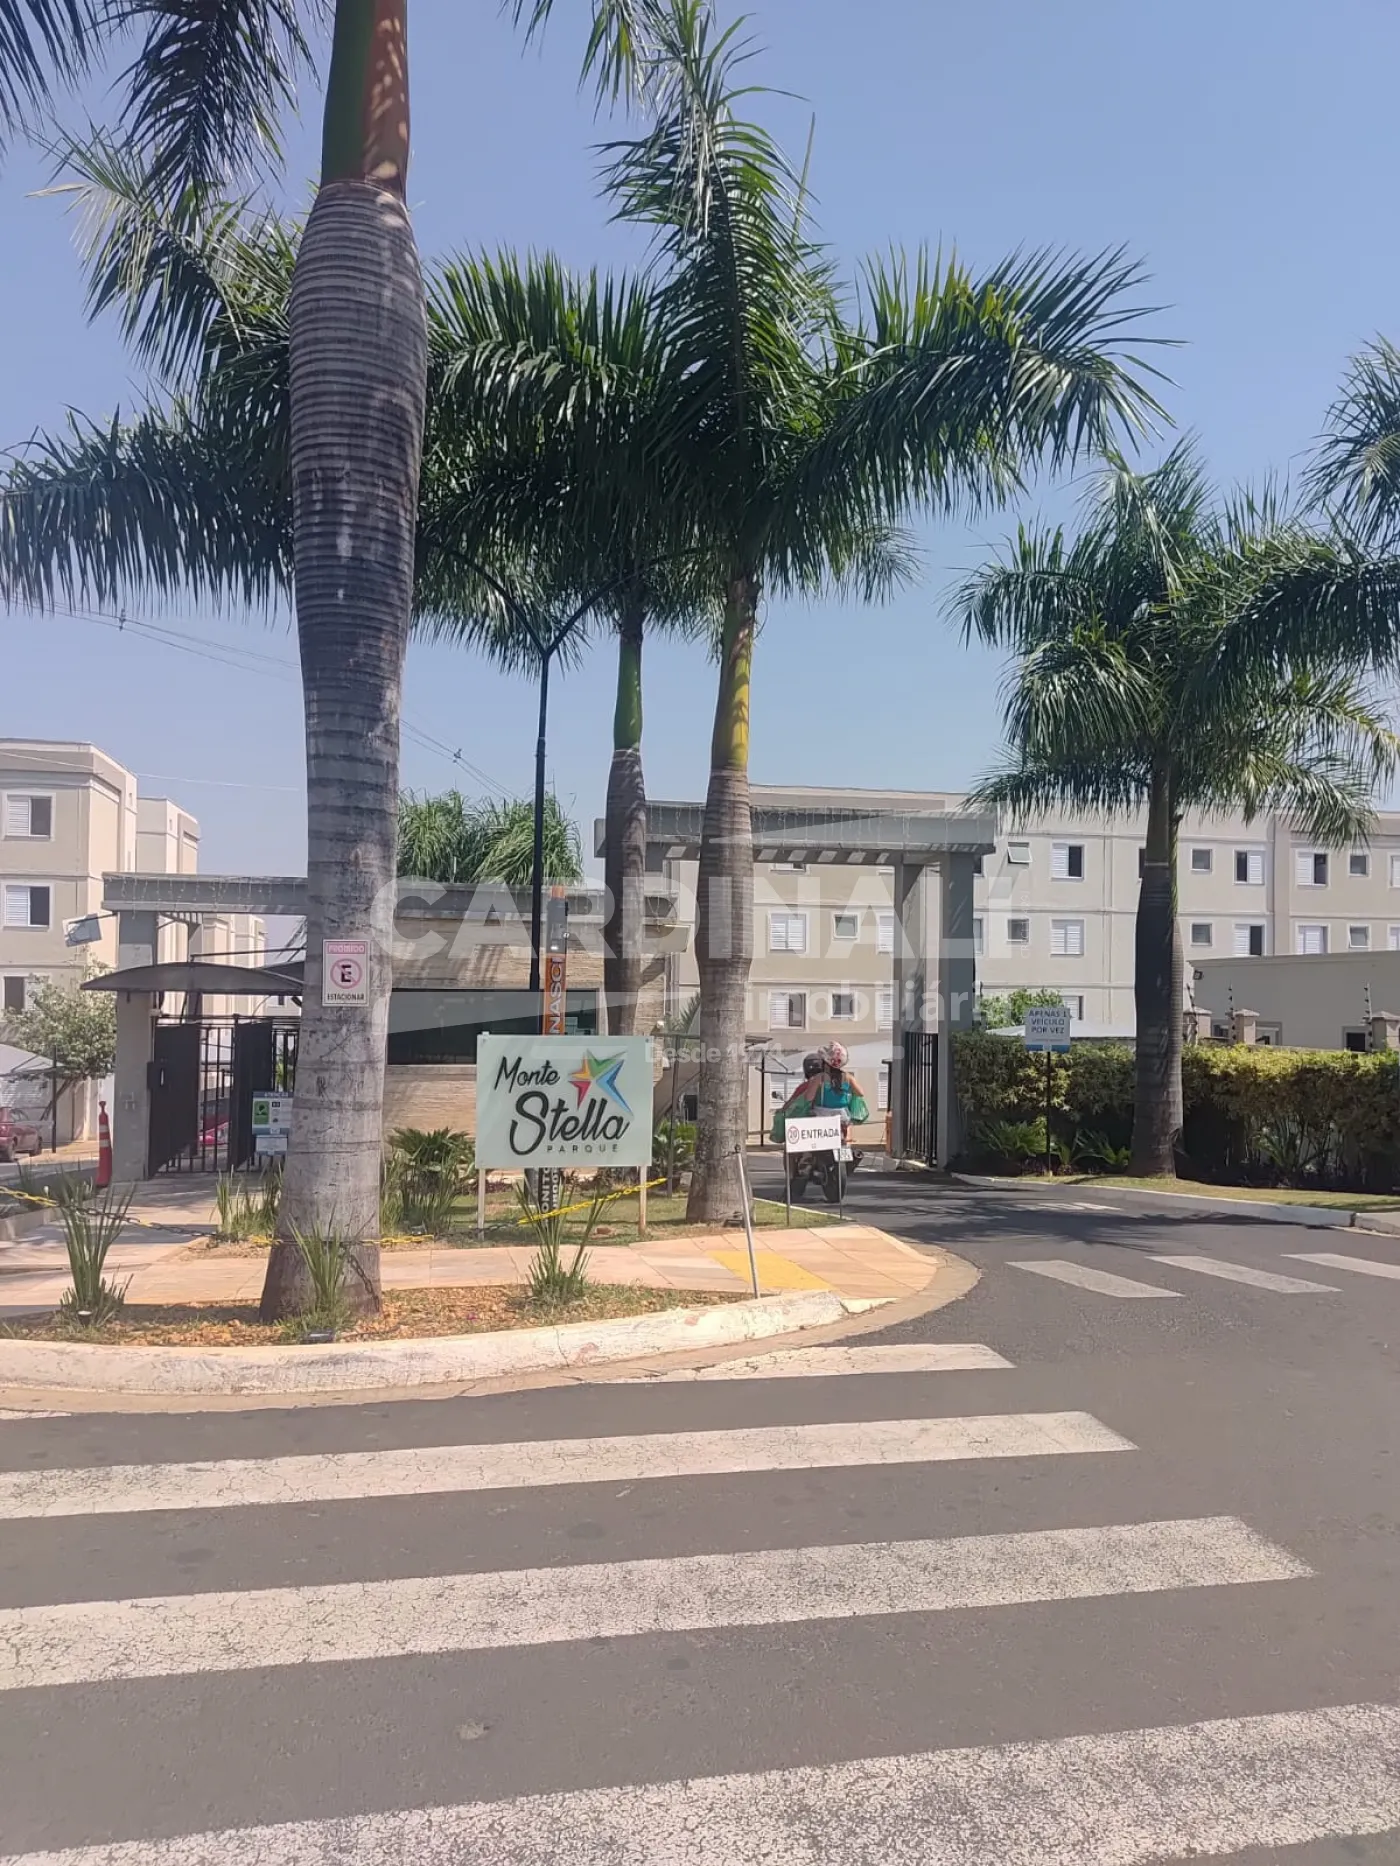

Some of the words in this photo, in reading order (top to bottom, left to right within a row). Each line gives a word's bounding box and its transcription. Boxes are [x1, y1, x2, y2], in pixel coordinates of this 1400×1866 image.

[327, 993, 365, 1001] ESTACIONAR
[1031, 1026, 1048, 1034] POR
[1050, 1026, 1065, 1034] VEZ
[493, 1056, 561, 1094] Monte
[509, 1091, 631, 1156] Stella
[801, 1128, 840, 1139] ENTRADA
[547, 1144, 618, 1153] PARQUE
